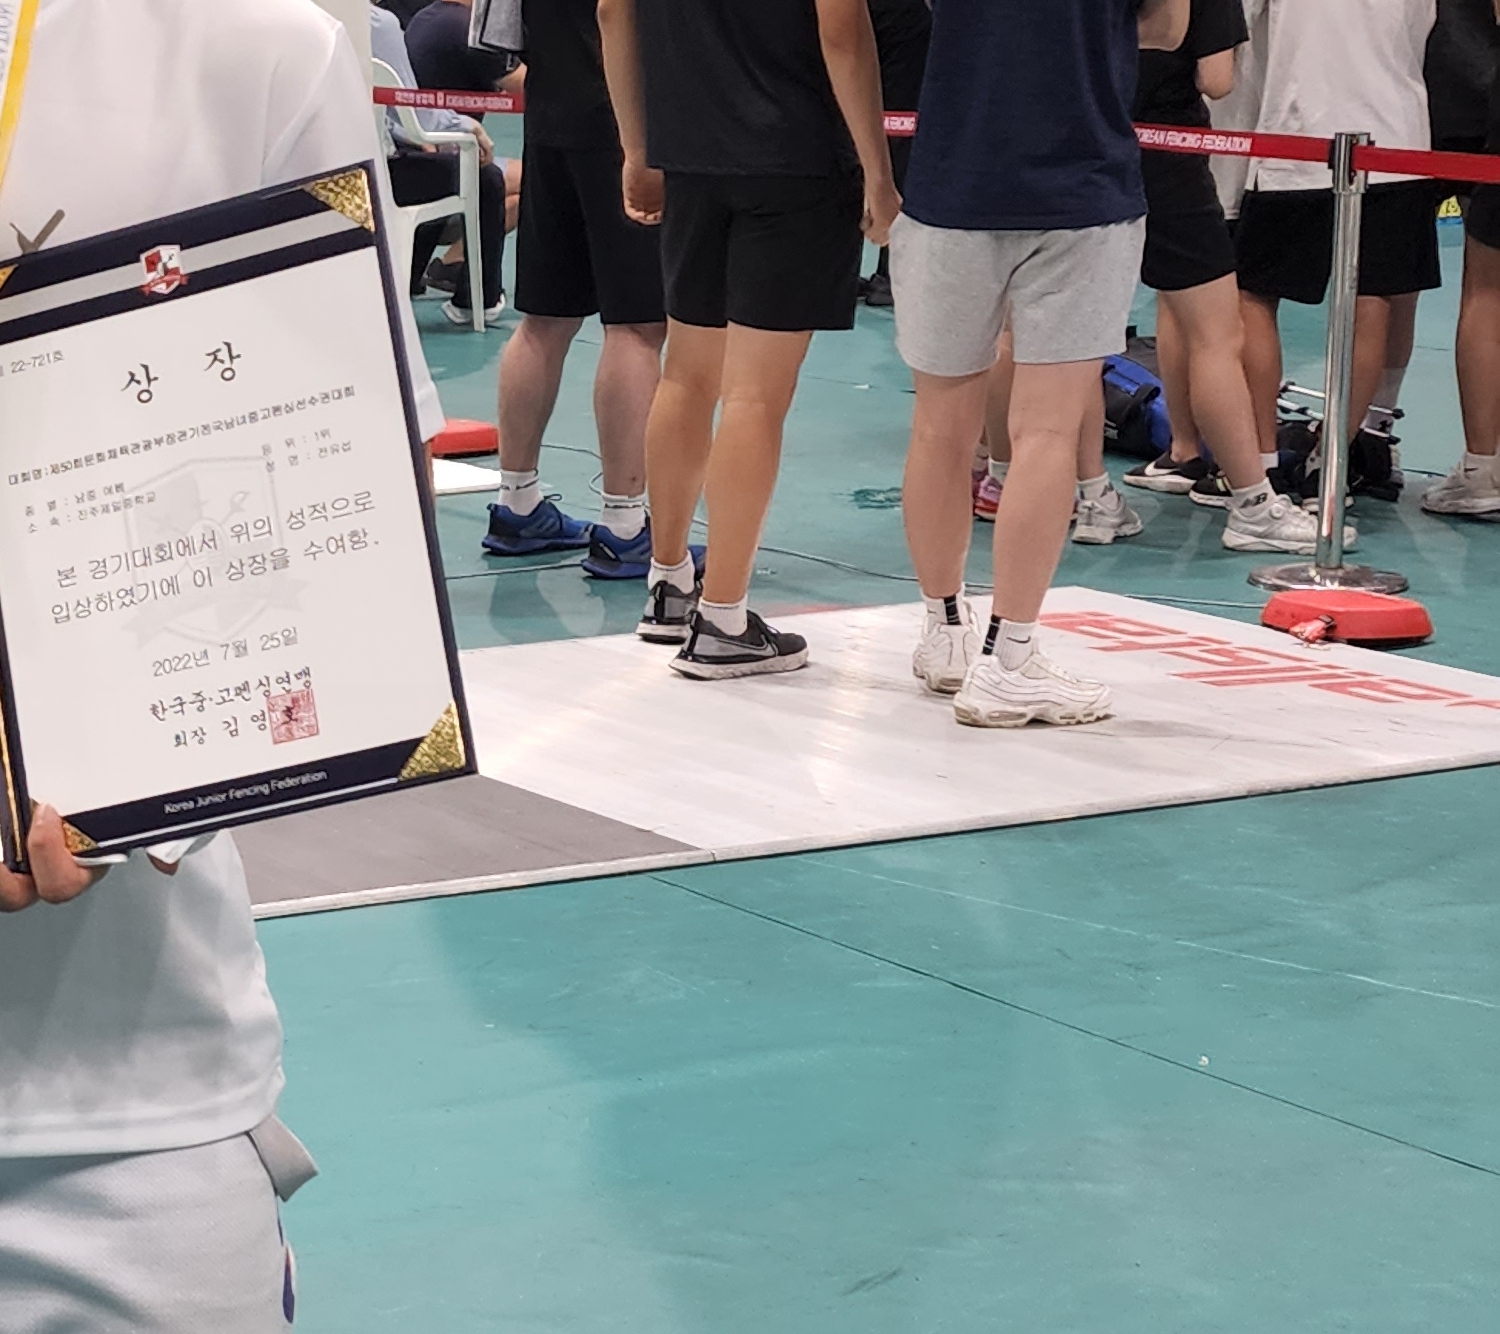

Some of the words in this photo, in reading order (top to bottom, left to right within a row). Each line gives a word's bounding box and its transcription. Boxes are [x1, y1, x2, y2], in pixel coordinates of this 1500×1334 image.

[51, 573, 181, 625] 입상하였기에
[192, 566, 213, 589] 이
[225, 546, 291, 582] 상장을
[303, 527, 380, 561] 수여함.
[56, 565, 77, 589] 본
[88, 529, 218, 580] 경기대회에서
[230, 515, 273, 544] 위의
[286, 490, 376, 531] 성적으로
[151, 648, 211, 678] 2022년
[219, 638, 249, 661] 7월
[259, 626, 298, 652] 25일
[163, 800, 195, 814] Korea
[268, 770, 328, 792] Federation
